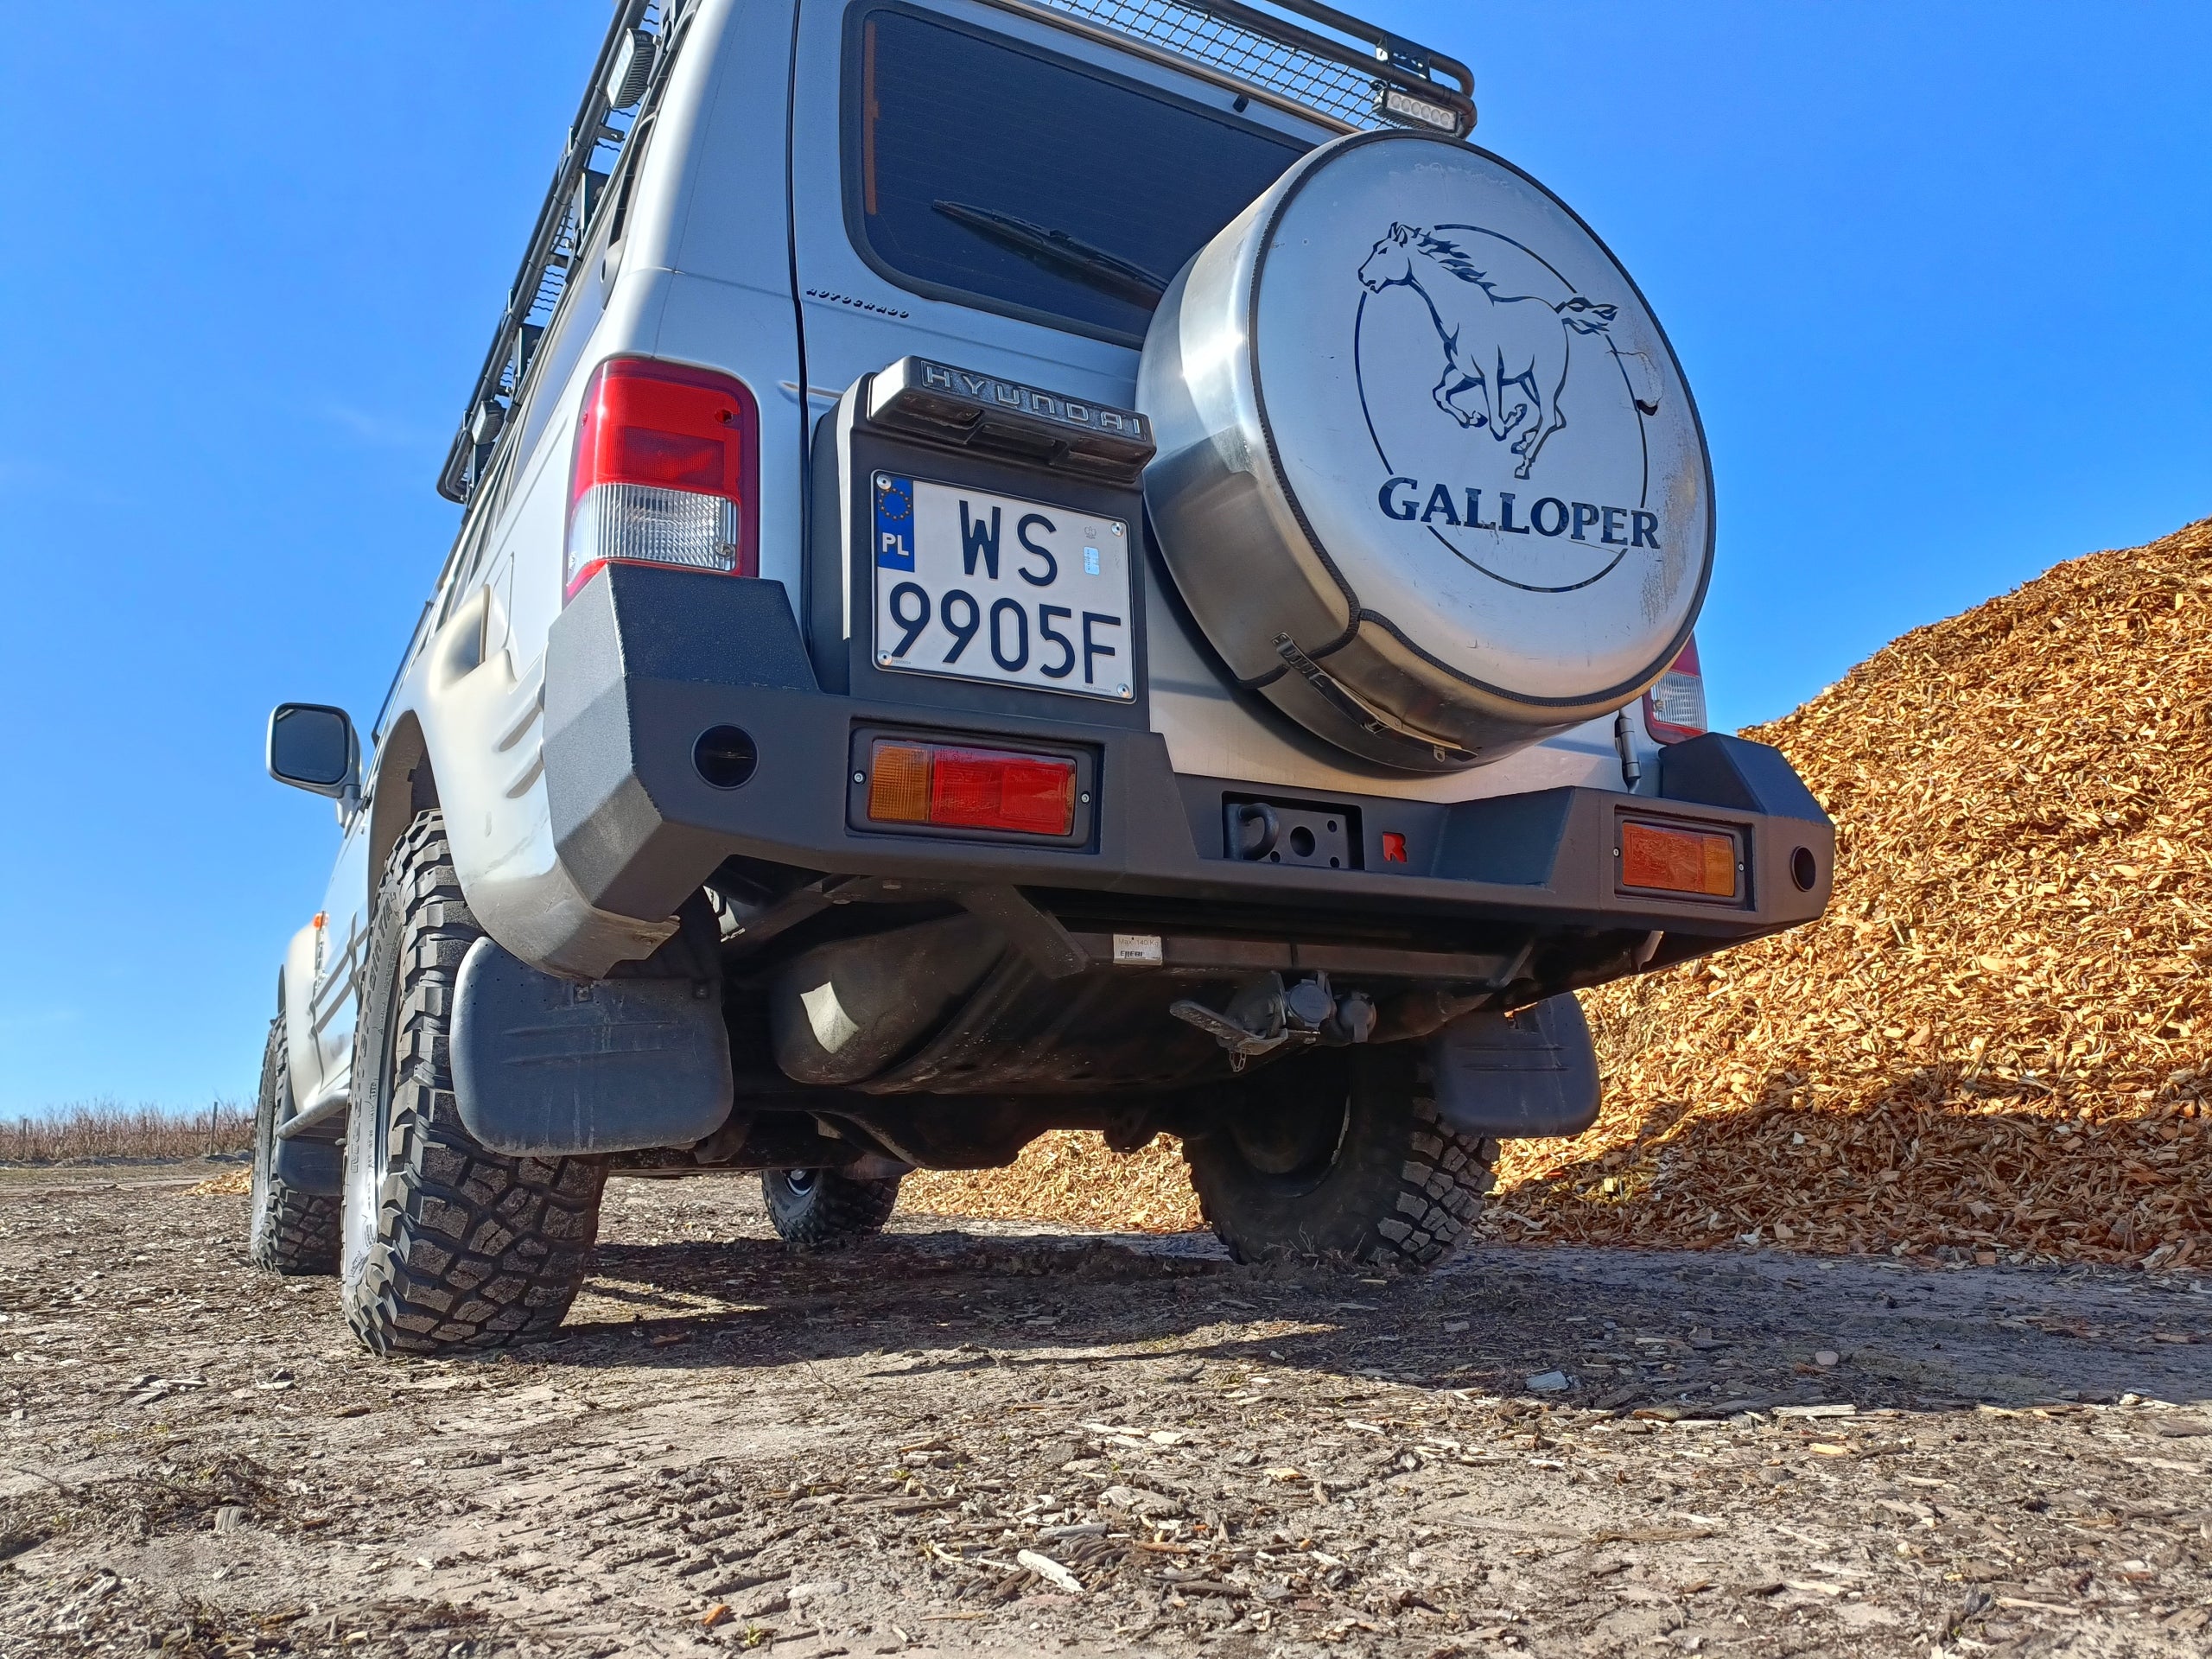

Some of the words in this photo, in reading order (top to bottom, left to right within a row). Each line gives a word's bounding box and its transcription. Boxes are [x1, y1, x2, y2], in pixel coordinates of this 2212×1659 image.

[926, 365, 1141, 434] HYUNDAI
[882, 532, 909, 556] PL
[958, 499, 1058, 587] WS
[1377, 475, 1661, 550] GALLOPER
[889, 581, 1122, 684] 9905F
